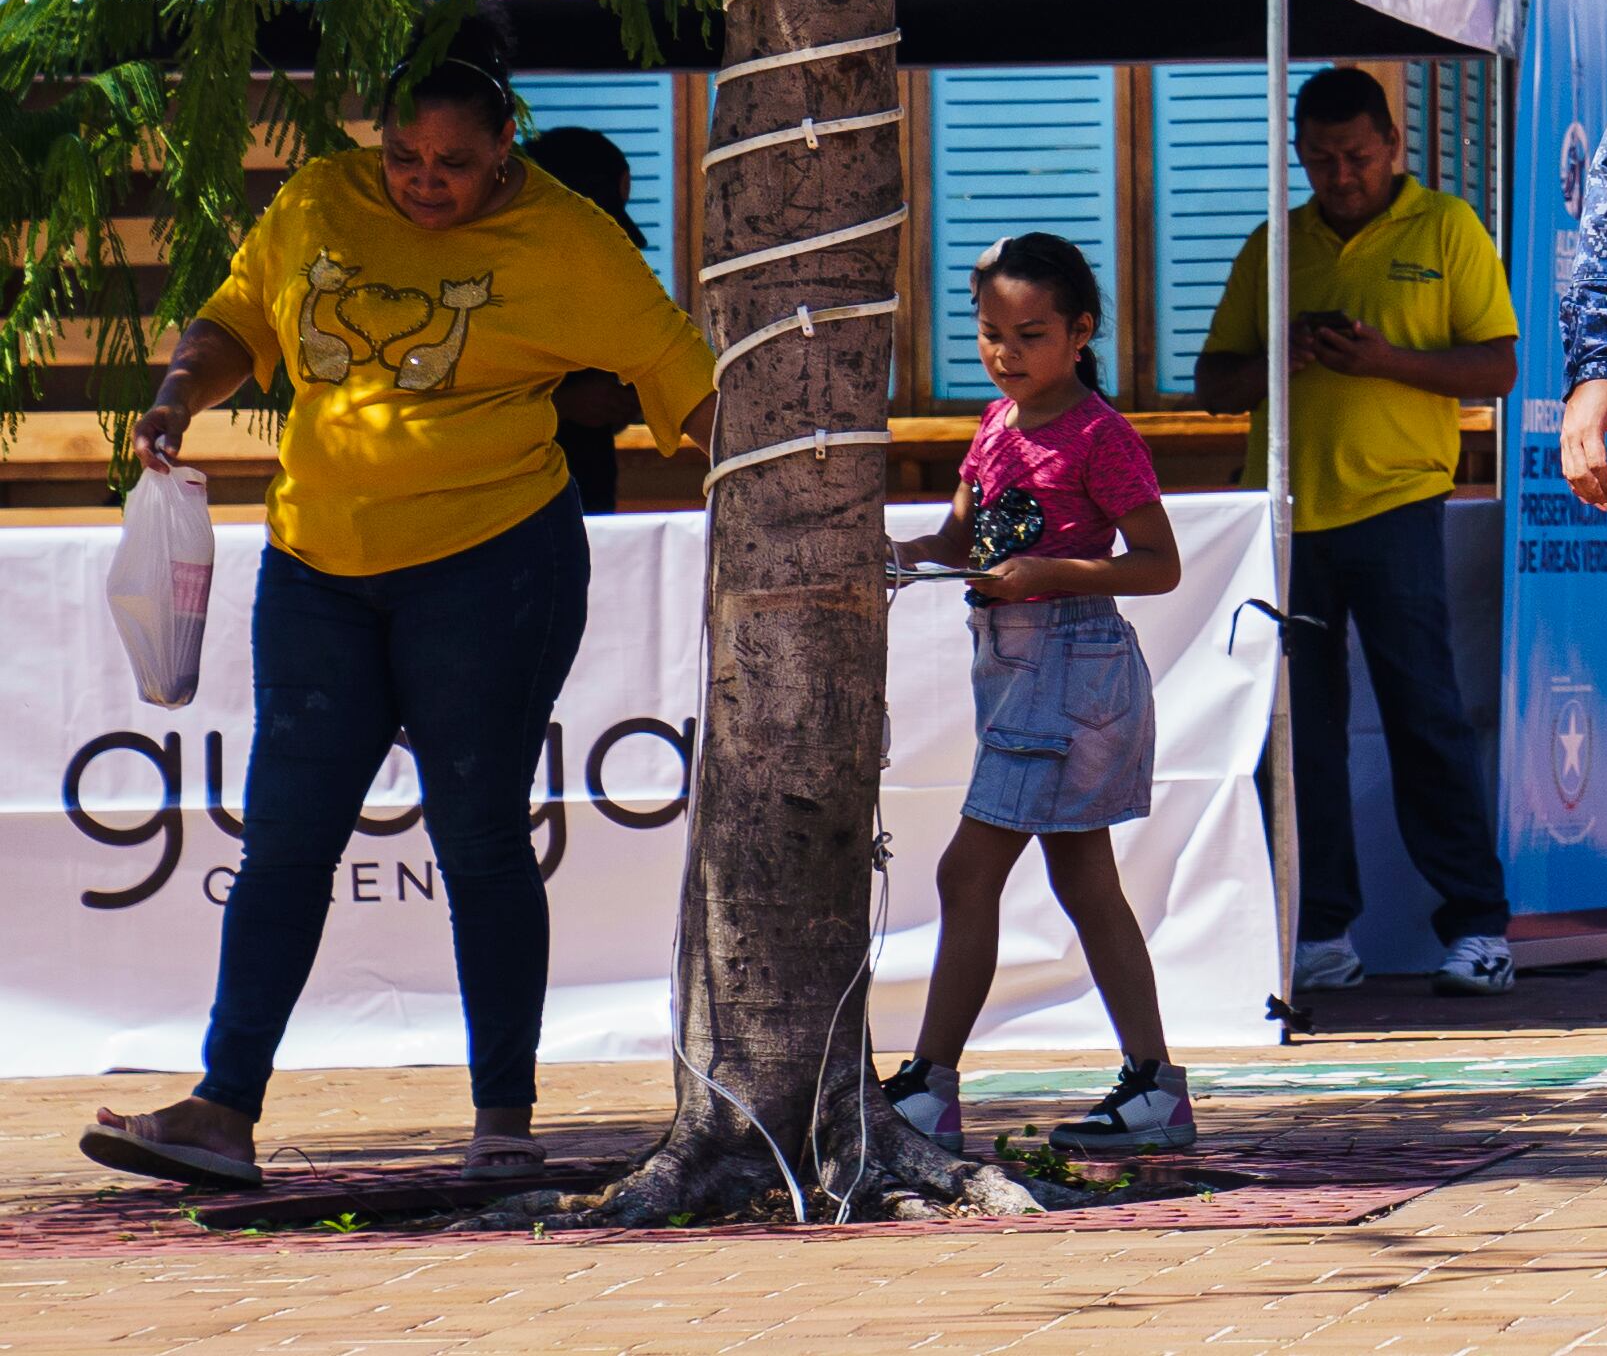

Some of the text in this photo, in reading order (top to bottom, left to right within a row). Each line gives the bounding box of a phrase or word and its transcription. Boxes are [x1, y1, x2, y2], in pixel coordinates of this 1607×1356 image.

[1523, 446, 1539, 479] DE
[1519, 540, 1539, 573] DE
[203, 860, 434, 907] GEN
